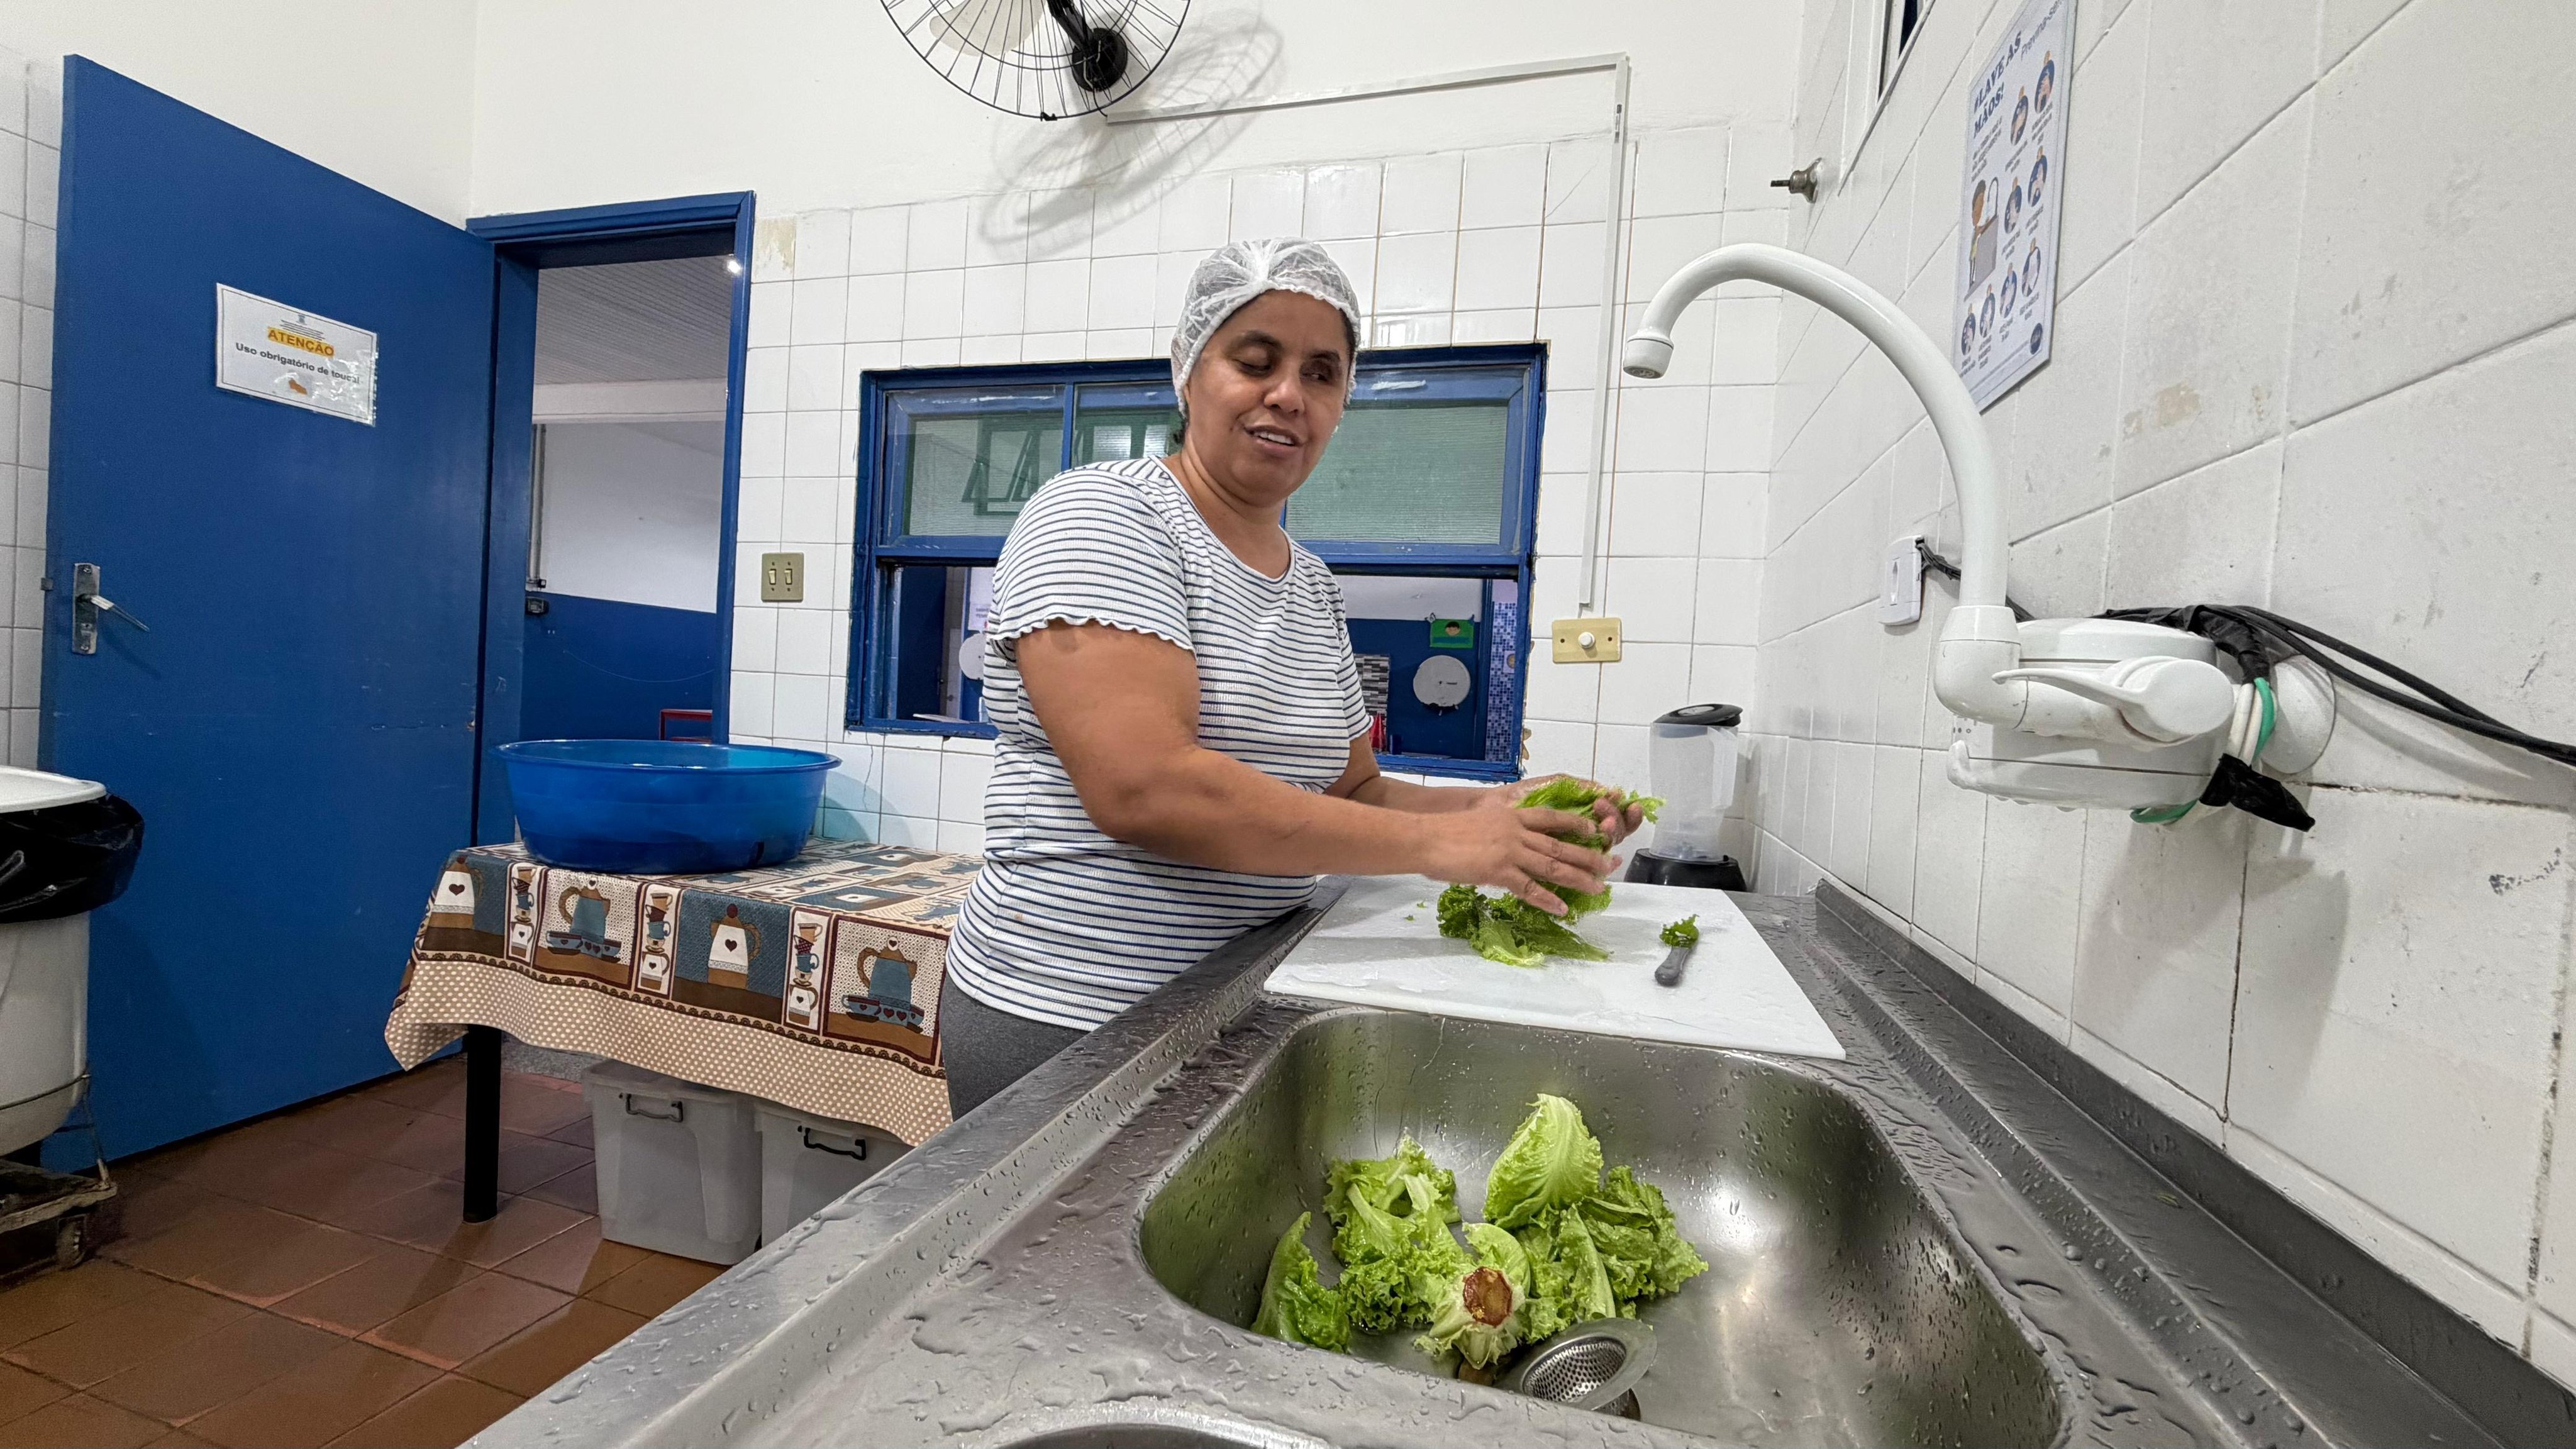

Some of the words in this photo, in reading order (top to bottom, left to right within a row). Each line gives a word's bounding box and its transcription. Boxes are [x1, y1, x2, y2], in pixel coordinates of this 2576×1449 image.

[2021, 0, 2062, 61] Previna-se
[2006, 31, 2021, 67] AS
[1973, 81, 2004, 140] MÃOS!
[236, 343, 257, 355] Uso
[260, 350, 314, 371] obrigatório
[317, 366, 329, 375] de
[268, 329, 335, 356] ATENÇÃO
